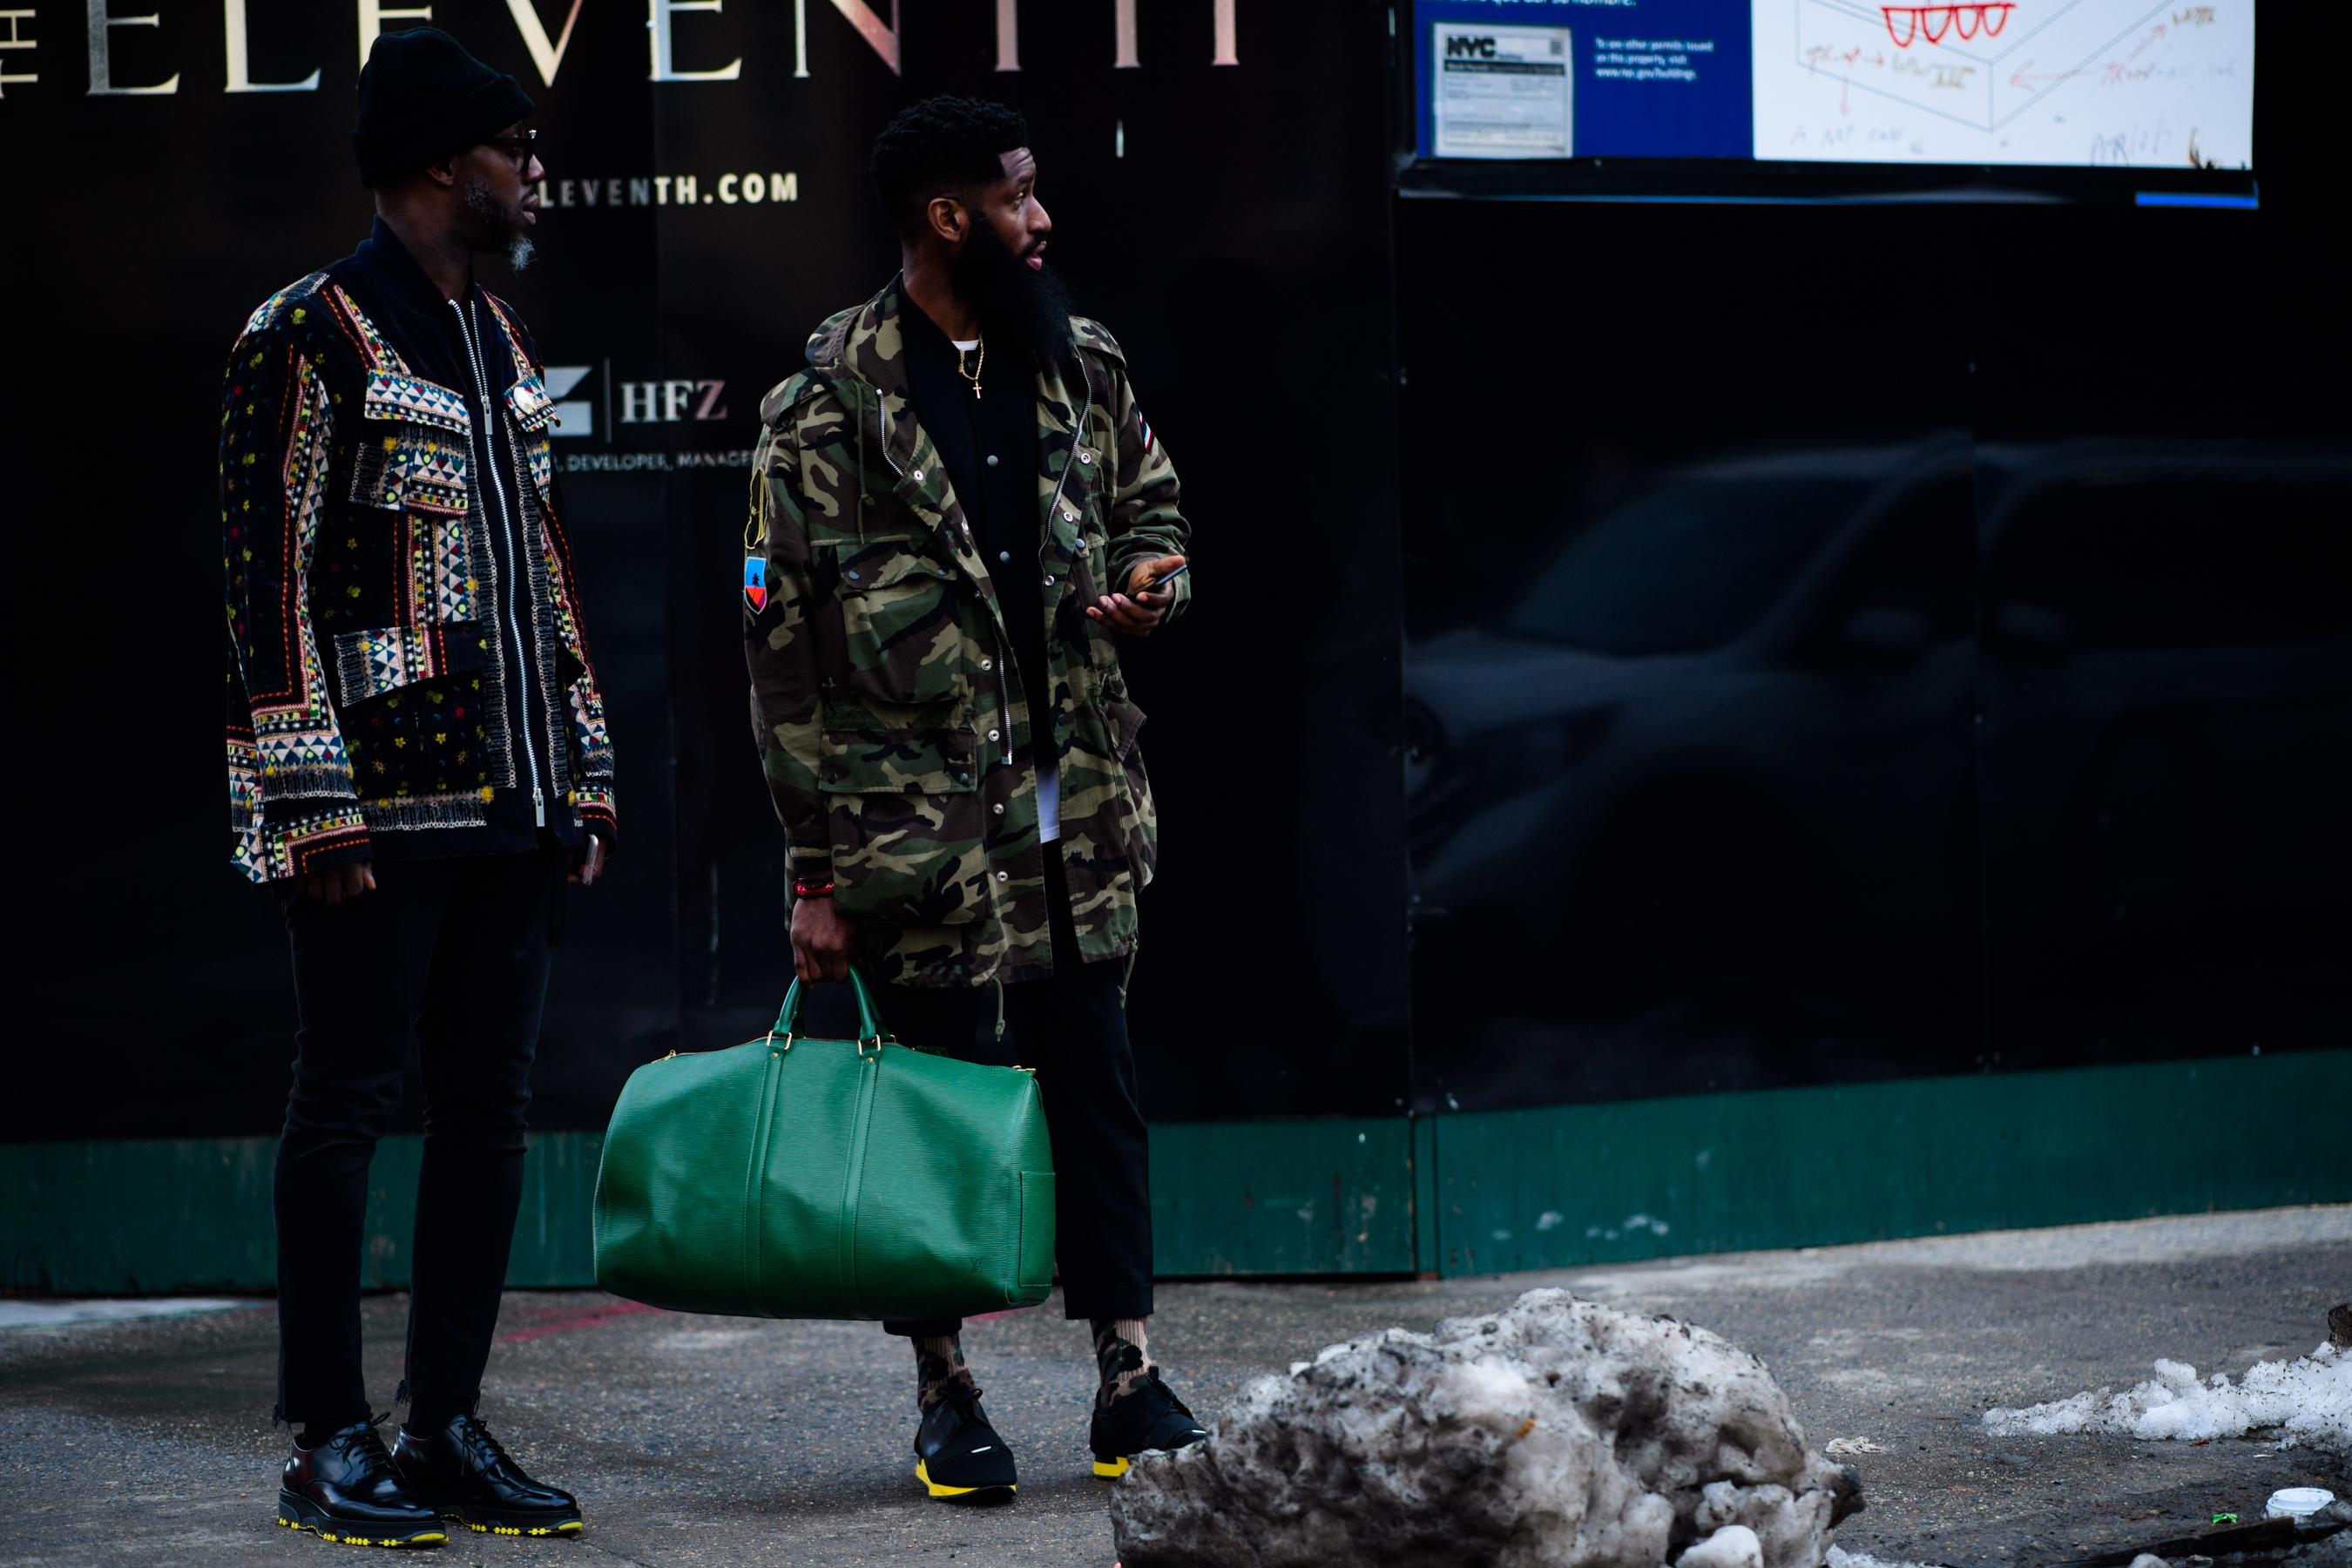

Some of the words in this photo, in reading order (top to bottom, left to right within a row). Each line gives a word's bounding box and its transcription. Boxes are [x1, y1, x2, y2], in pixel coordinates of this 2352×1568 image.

[1447, 37, 1497, 58] NYC
[618, 379, 728, 423] HFZ
[565, 451, 673, 472] DEVELOPER,
[675, 449, 755, 469] MANAGE
